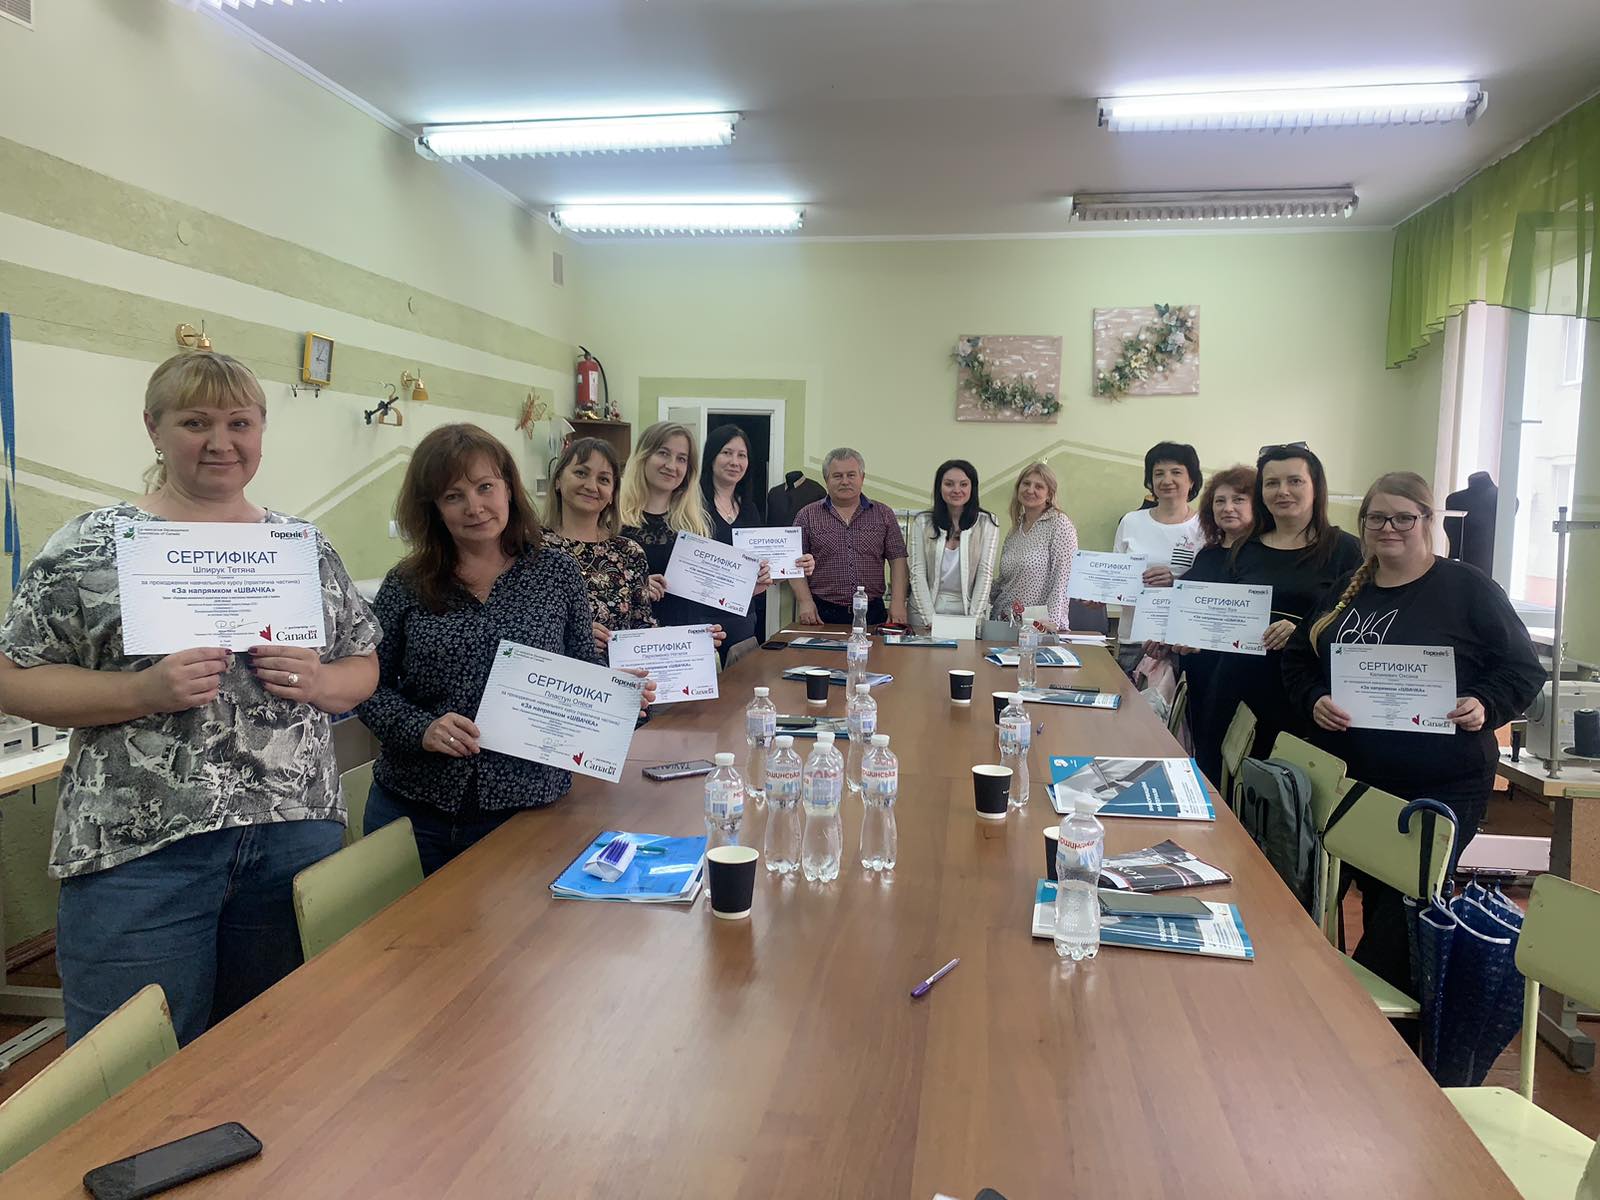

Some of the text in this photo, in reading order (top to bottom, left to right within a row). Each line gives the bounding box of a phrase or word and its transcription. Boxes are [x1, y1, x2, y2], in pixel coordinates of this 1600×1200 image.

[167, 550, 278, 564] СЕРТИФІКАТ
[693, 549, 742, 570] СЕРТИФІКАТ
[193, 566, 225, 574] Шпирук
[1089, 561, 1133, 571] СЕРТИФІКАТ
[1194, 596, 1251, 608] СЕРТИФІКАТ
[276, 630, 318, 642] Canada
[633, 641, 693, 654] СЕРТИФІКАТ
[1359, 661, 1429, 673] СЕРТИФІКАТ
[527, 672, 613, 704] СЕРТИФІКАТ
